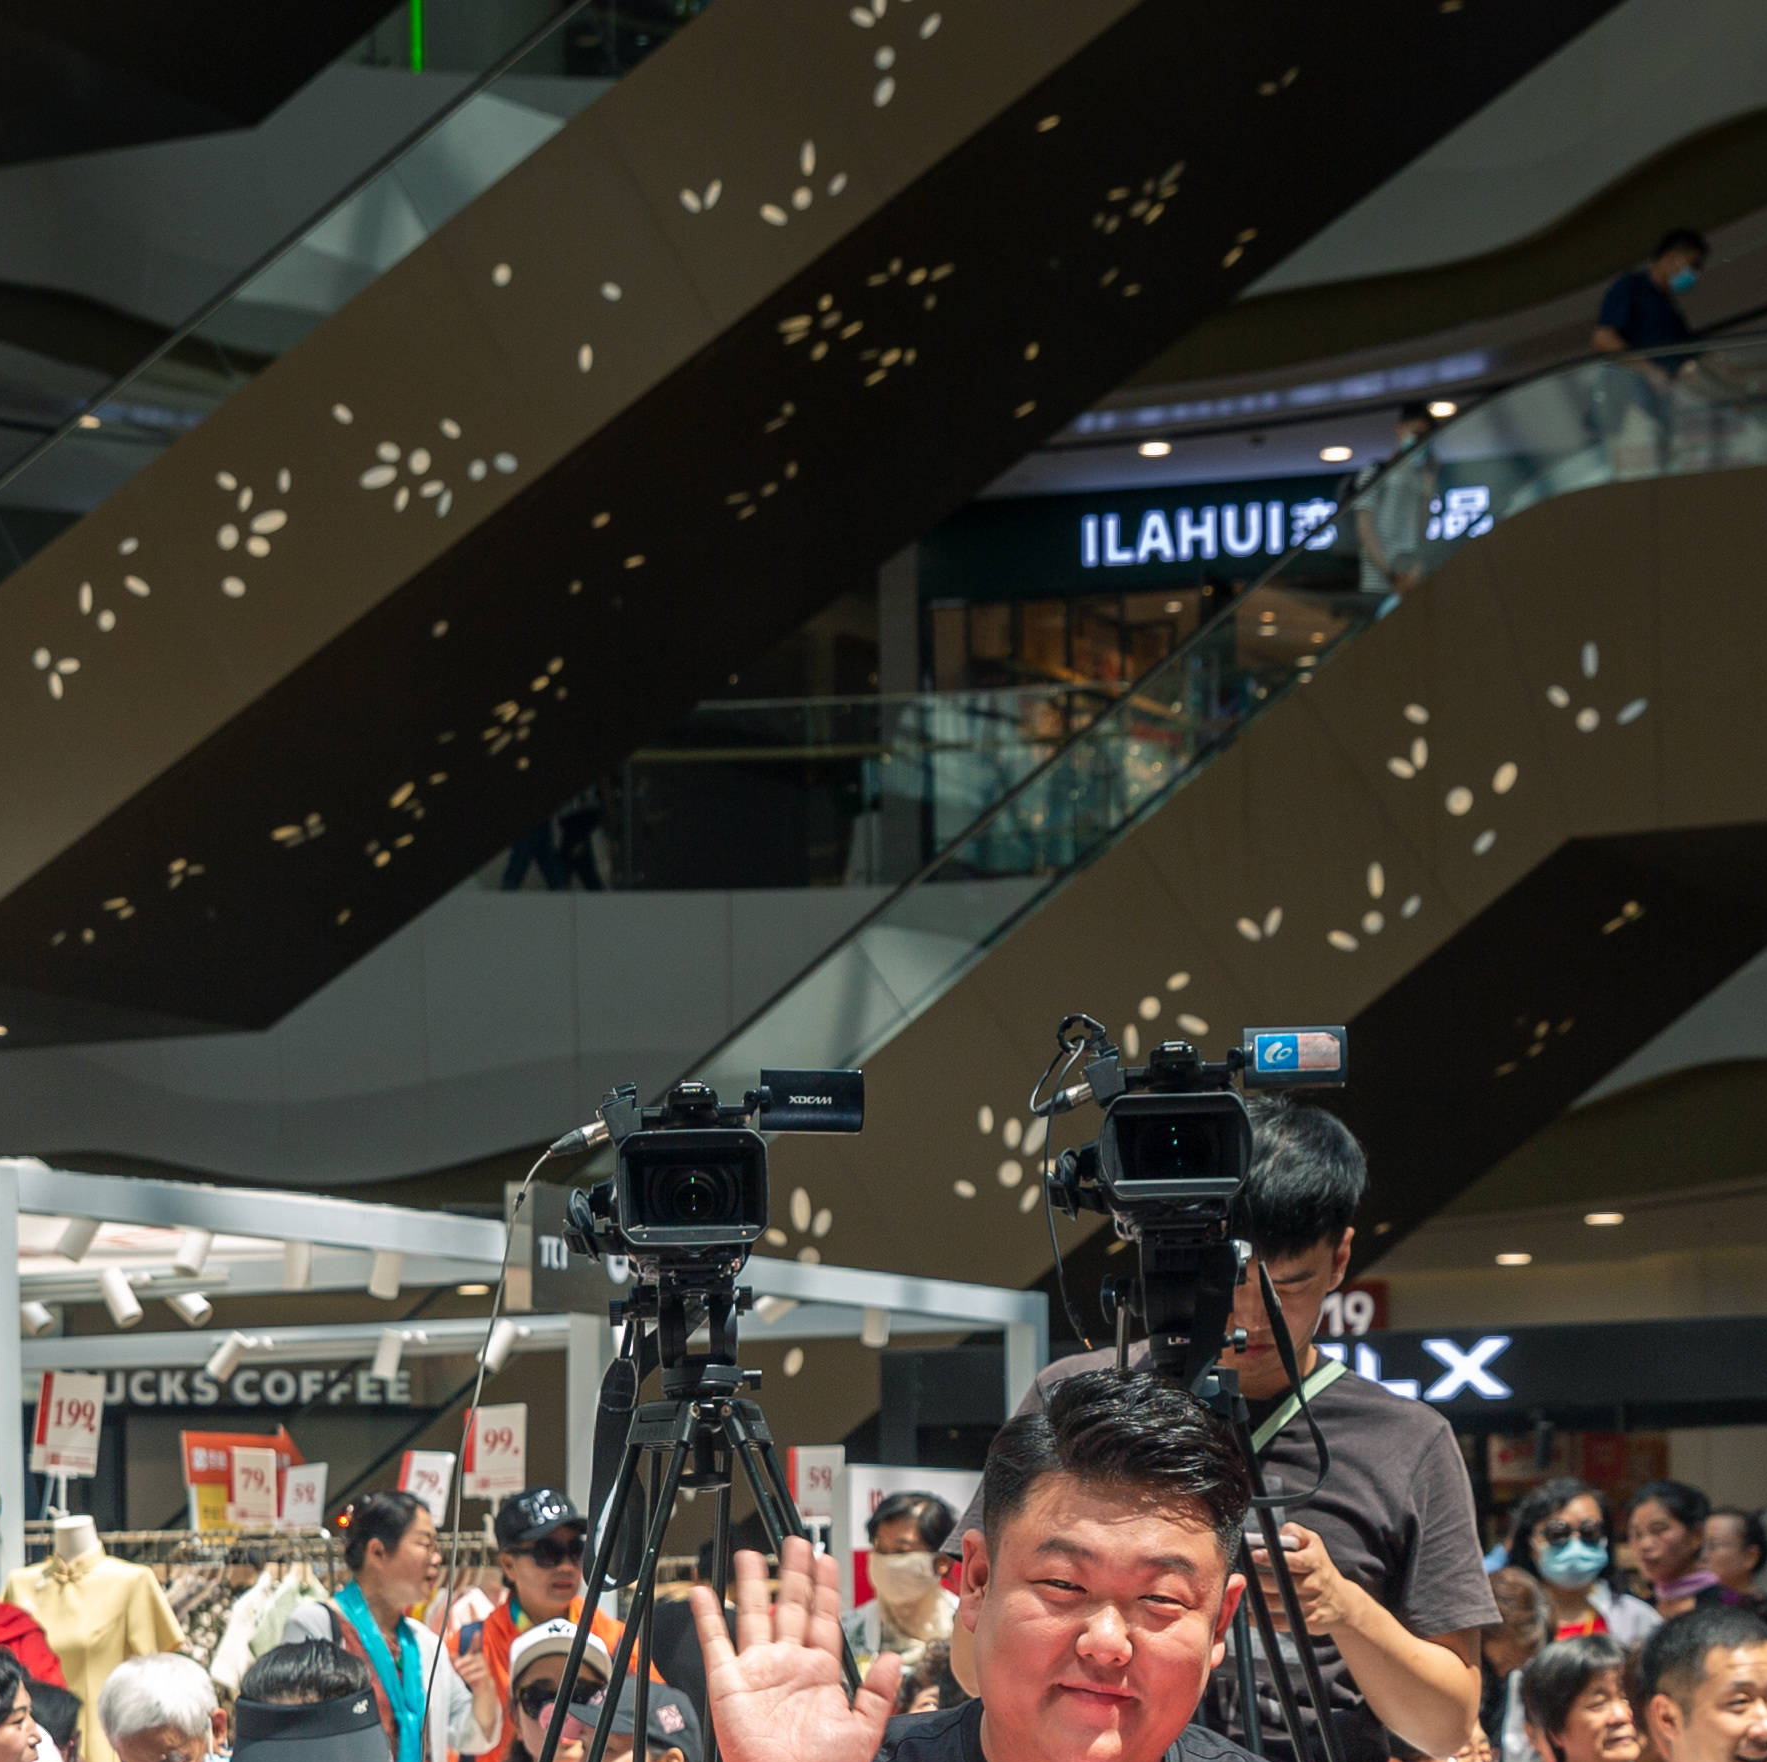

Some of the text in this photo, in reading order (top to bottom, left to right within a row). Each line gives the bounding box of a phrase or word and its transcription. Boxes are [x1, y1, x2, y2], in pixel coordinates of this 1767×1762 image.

[1081, 500, 1285, 568] ILAHUI
[234, 1368, 412, 1406] COFFEE
[1317, 1335, 1513, 1402] LX
